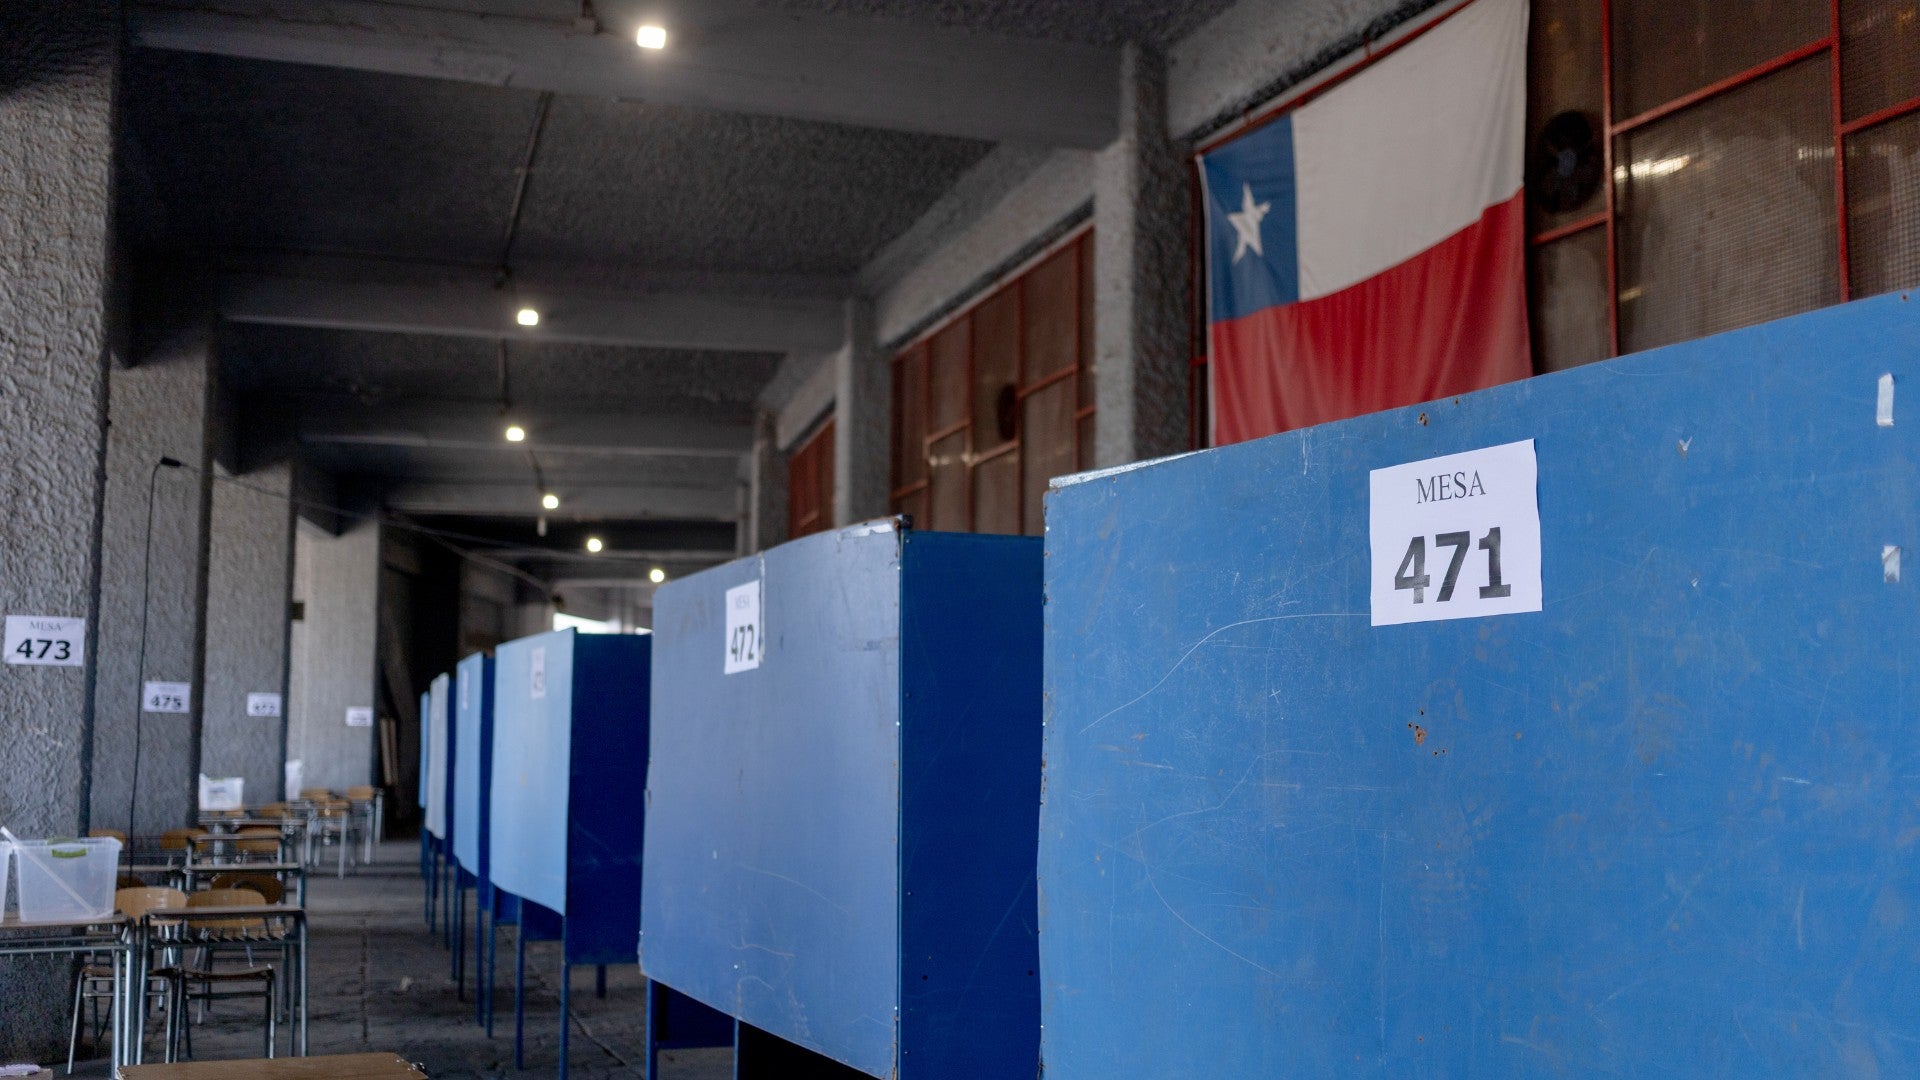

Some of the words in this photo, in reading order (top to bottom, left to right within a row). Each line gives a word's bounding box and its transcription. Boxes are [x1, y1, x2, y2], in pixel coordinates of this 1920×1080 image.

[1416, 470, 1486, 504] MESA
[1394, 526, 1512, 605] 471
[17, 638, 71, 660] 473
[731, 624, 754, 662] 472
[151, 694, 181, 710] 475
